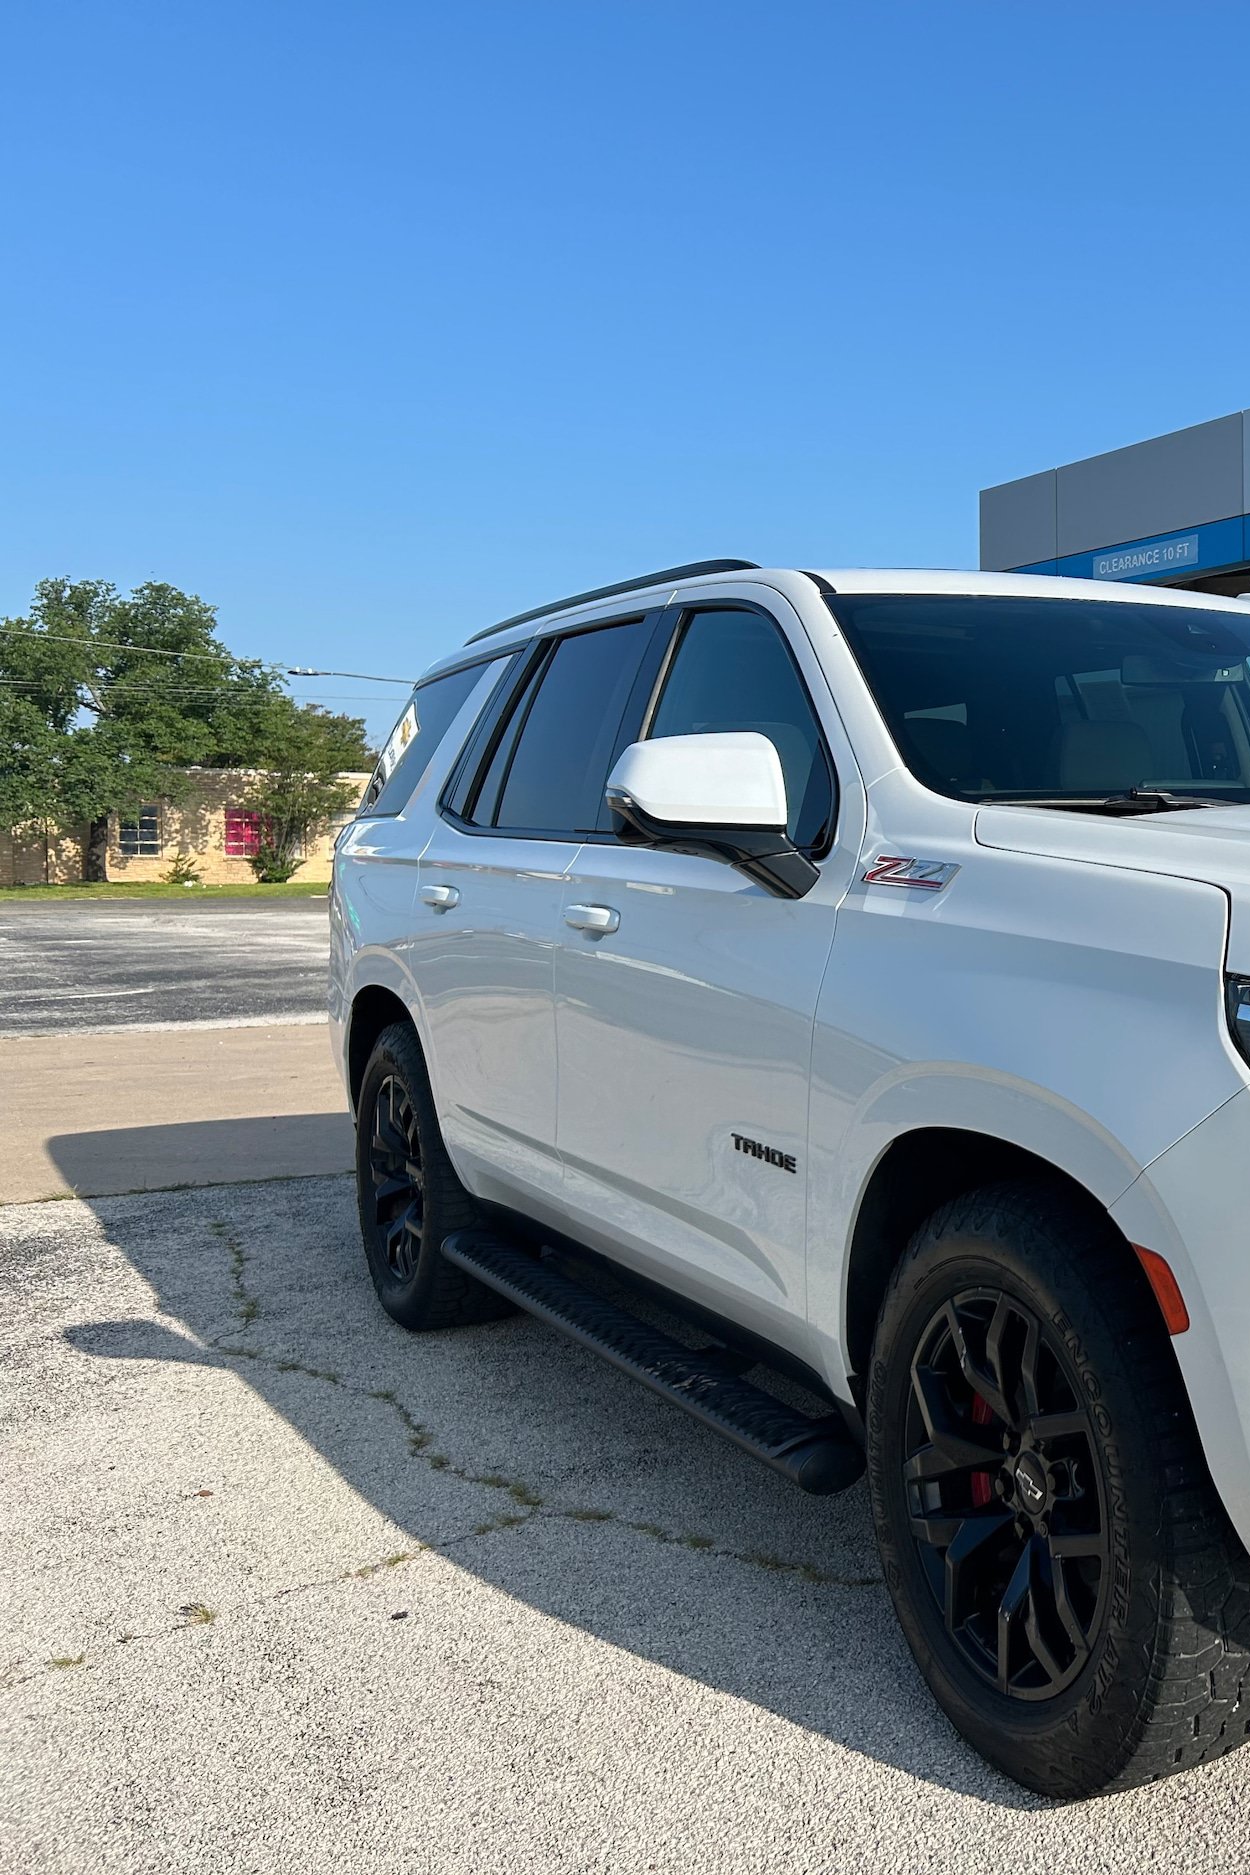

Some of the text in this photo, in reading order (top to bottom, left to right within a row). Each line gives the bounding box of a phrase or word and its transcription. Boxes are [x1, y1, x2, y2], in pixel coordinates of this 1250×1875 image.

[1099, 543, 1190, 574] CLEARANCE 10 FT
[730, 1132, 797, 1174] TAHOE
[1052, 1306, 1131, 1631] ENCOUNTER
